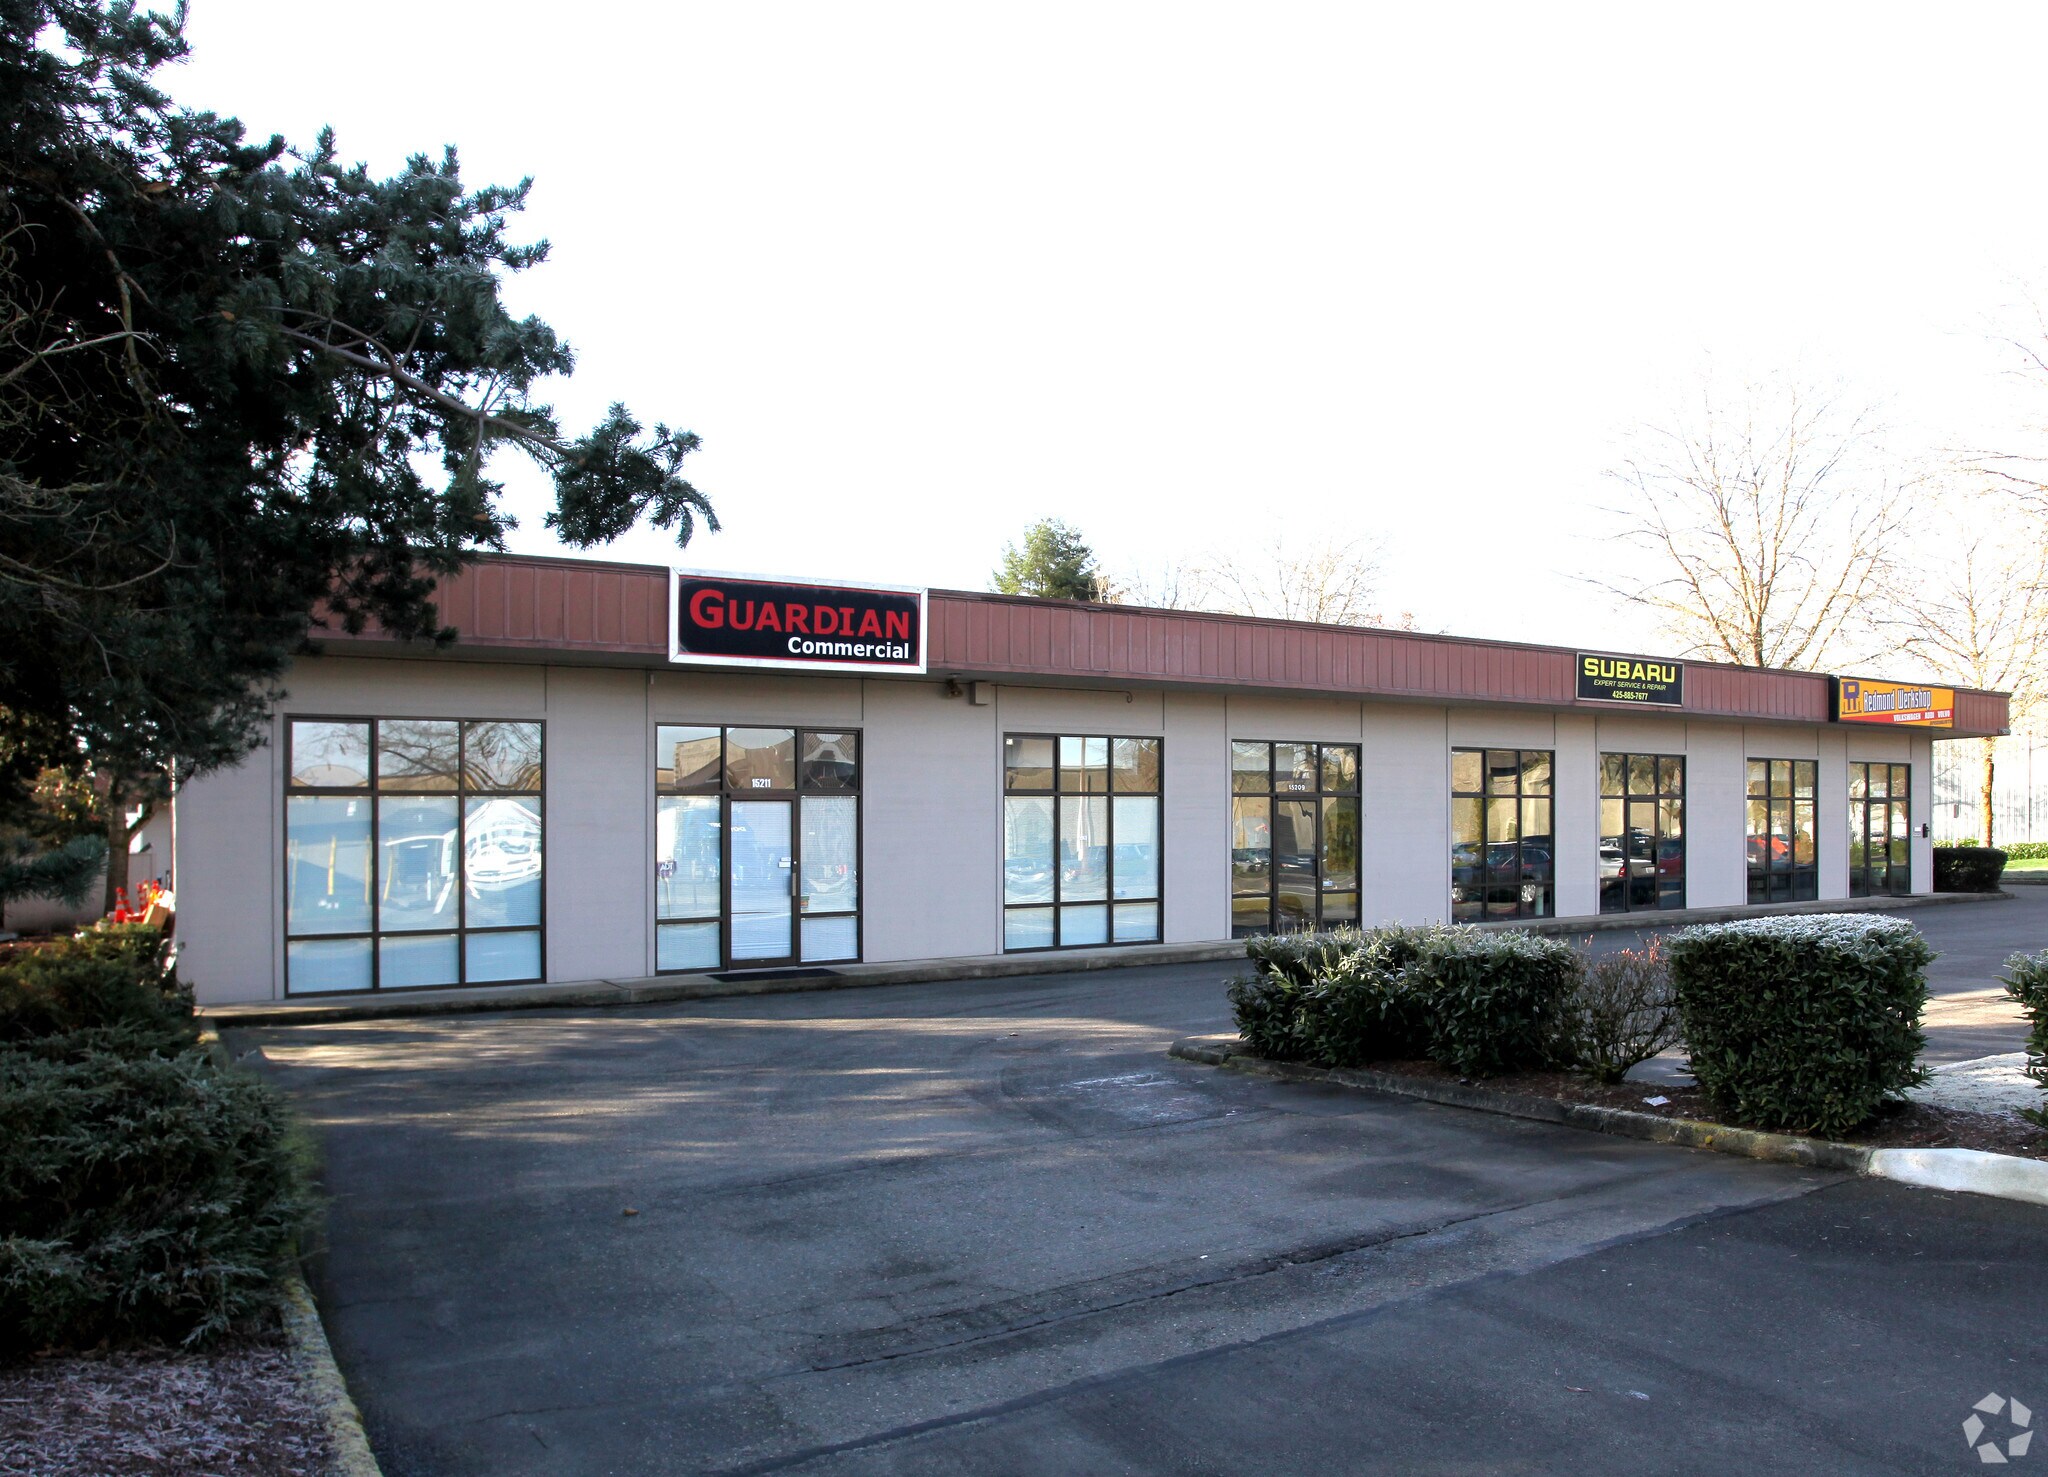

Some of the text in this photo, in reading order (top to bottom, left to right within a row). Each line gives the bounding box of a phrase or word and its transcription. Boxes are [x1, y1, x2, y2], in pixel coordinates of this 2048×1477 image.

[689, 589, 910, 640] GUARDIAN
[787, 637, 909, 659] Commercial
[1584, 658, 1675, 682] SUBARU
[1864, 688, 1931, 712] Redmond Werkshop
[752, 778, 771, 788] 15211
